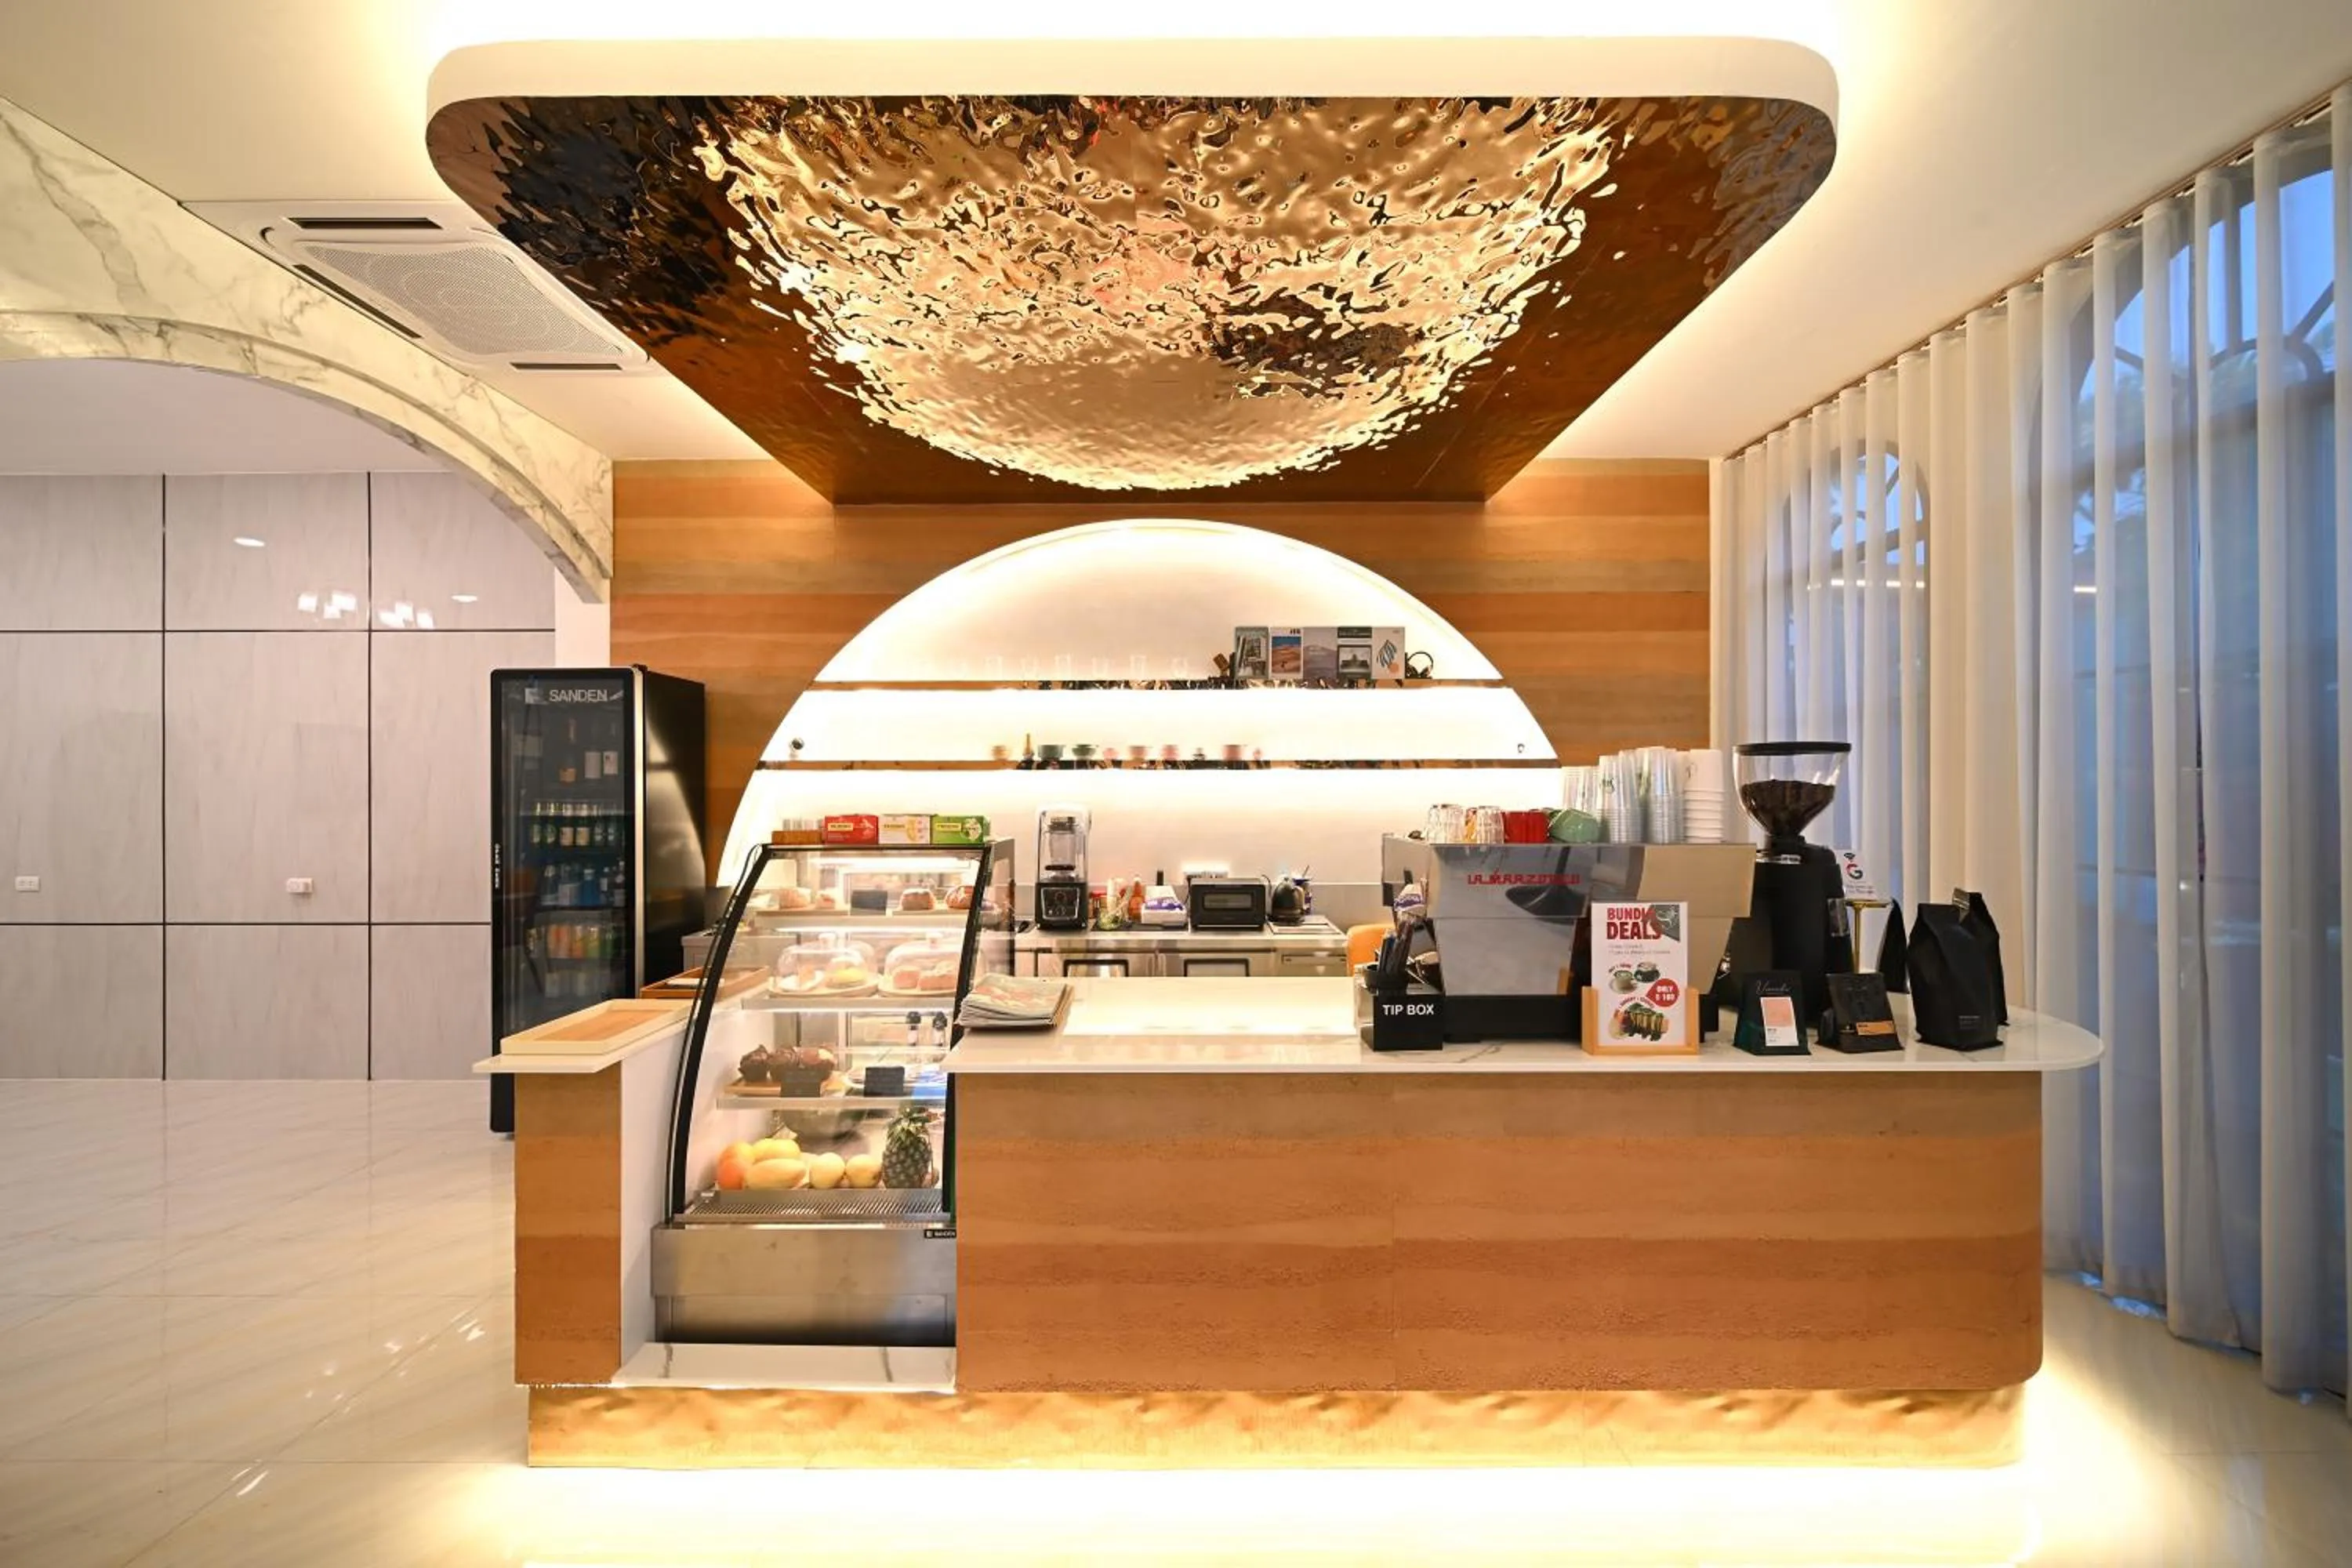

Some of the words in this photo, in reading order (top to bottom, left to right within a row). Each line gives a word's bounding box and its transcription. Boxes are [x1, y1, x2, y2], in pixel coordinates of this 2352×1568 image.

[549, 689, 608, 702] SANDEN
[1606, 921, 1661, 940] DEALS
[1382, 1004, 1403, 1015] TIP
[1407, 1004, 1434, 1015] BOX
